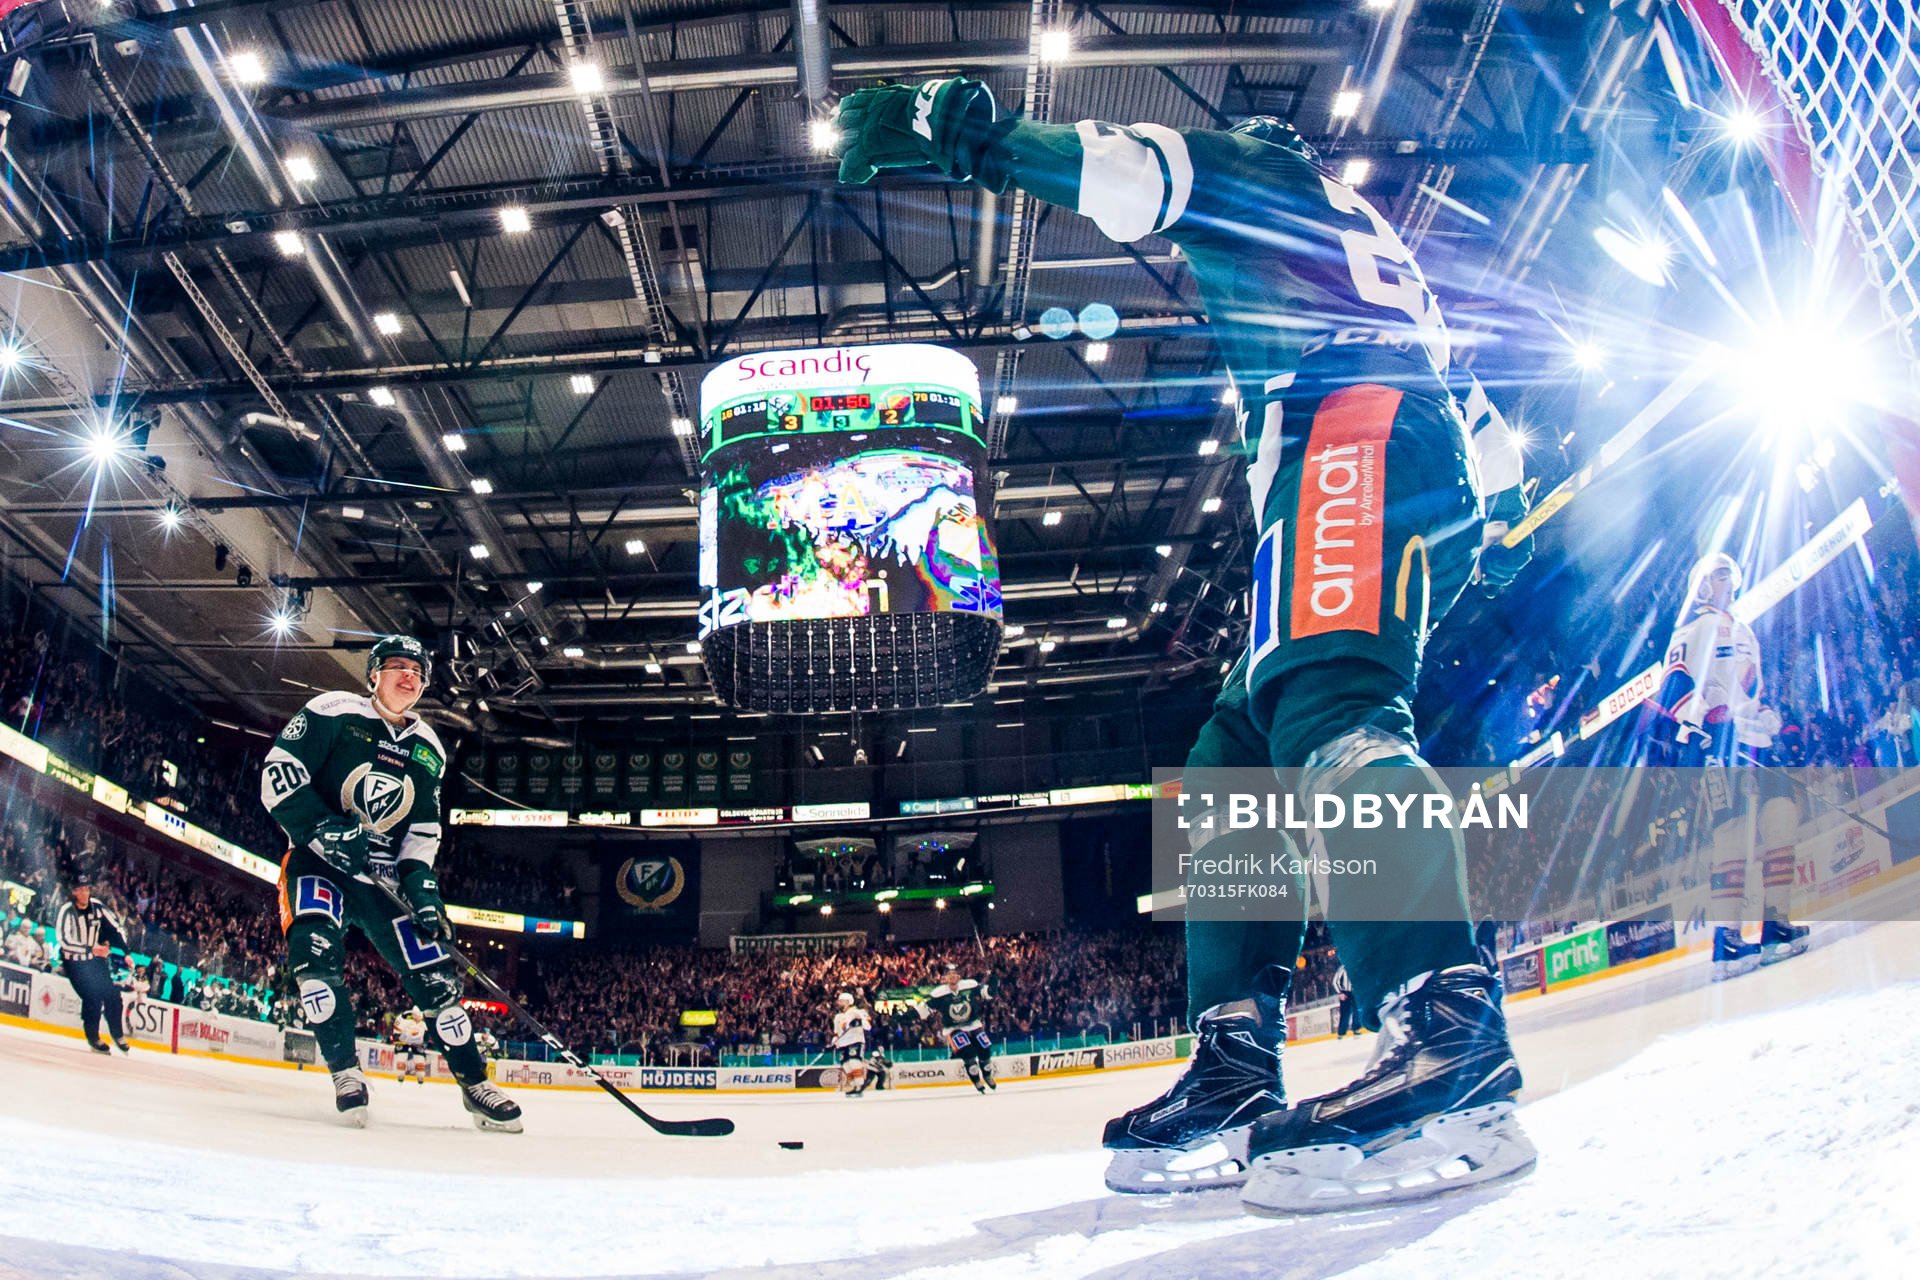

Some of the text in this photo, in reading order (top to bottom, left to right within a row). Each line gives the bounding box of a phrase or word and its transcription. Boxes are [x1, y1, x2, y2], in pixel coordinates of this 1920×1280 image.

[811, 394, 870, 411] 01:50
[784, 416, 798, 430] 3
[885, 410, 899, 424] 2
[1359, 444, 1375, 527] by ArcelorMittal
[1310, 444, 1359, 617] armat
[378, 740, 410, 757] stadium
[268, 762, 302, 796] 20
[370, 779, 387, 802] F
[1551, 936, 1600, 979] print
[136, 1001, 168, 1035] SST
[641, 1071, 716, 1089] HÖJDENS
[732, 1074, 793, 1085] REJLERS
